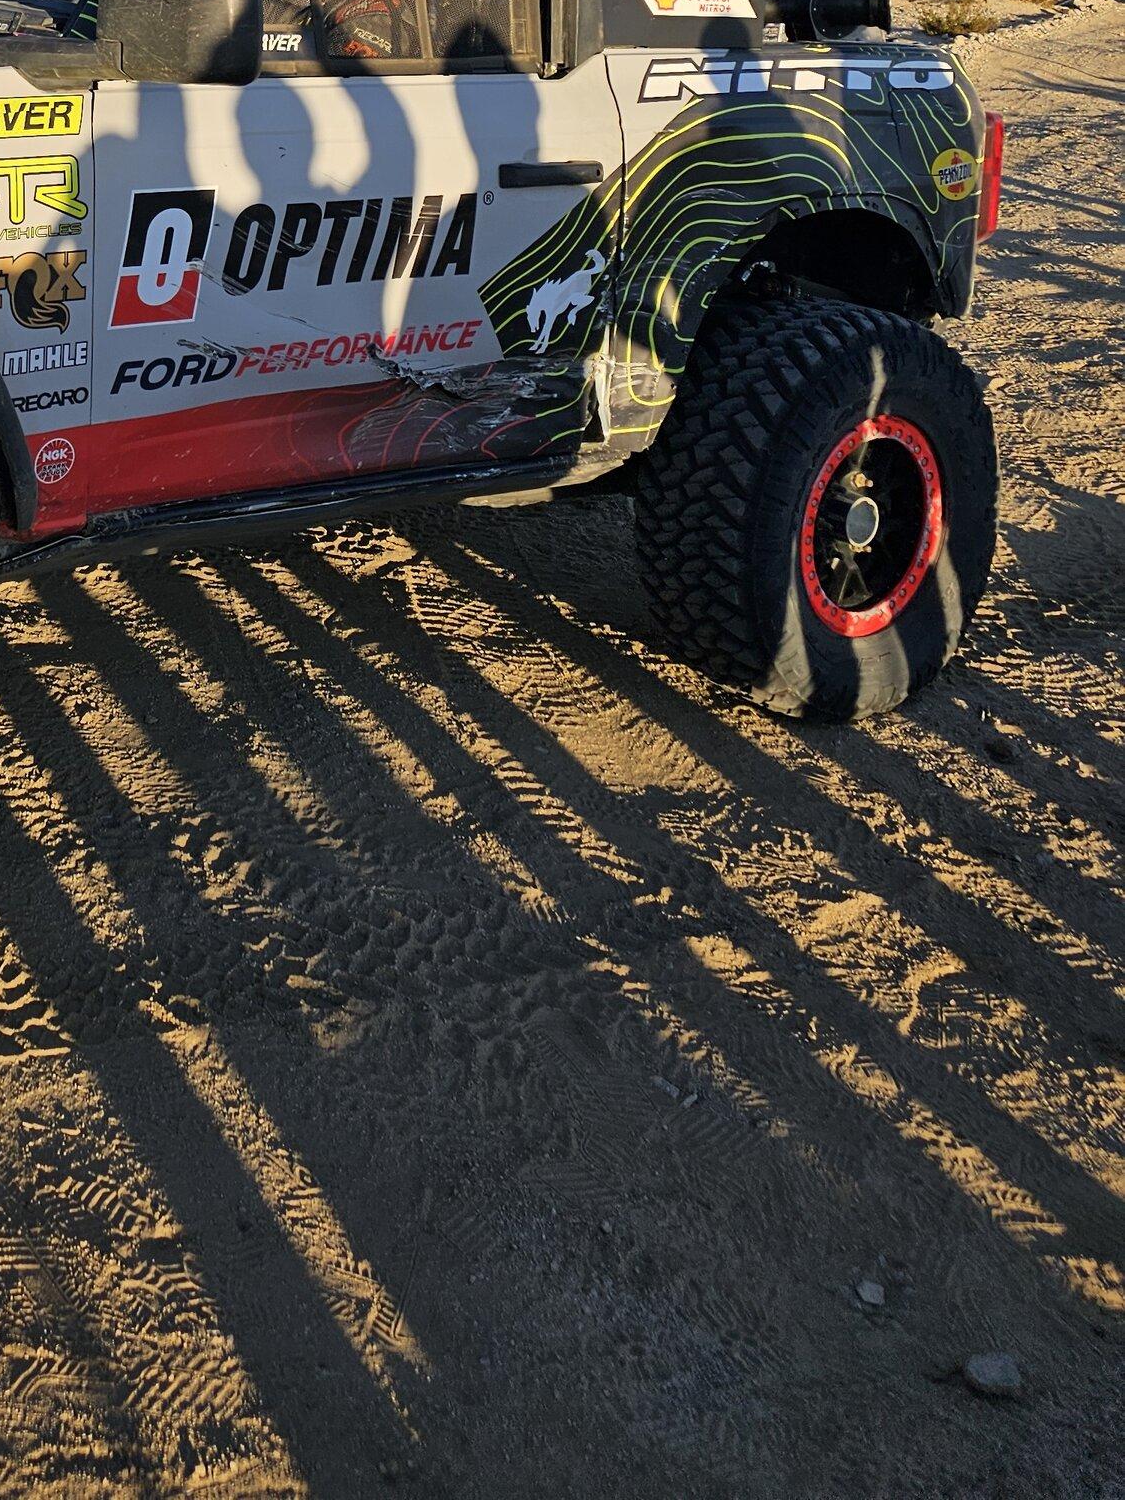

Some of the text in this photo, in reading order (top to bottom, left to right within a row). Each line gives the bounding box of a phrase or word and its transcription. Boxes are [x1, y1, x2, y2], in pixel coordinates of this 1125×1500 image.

[637, 57, 956, 103] NITTO
[938, 163, 973, 186] PENNZOIL
[221, 192, 478, 296] OPTIMA
[2, 341, 88, 376] MAHLE
[13, 386, 89, 413] RECARO
[42, 448, 68, 463] NGK
